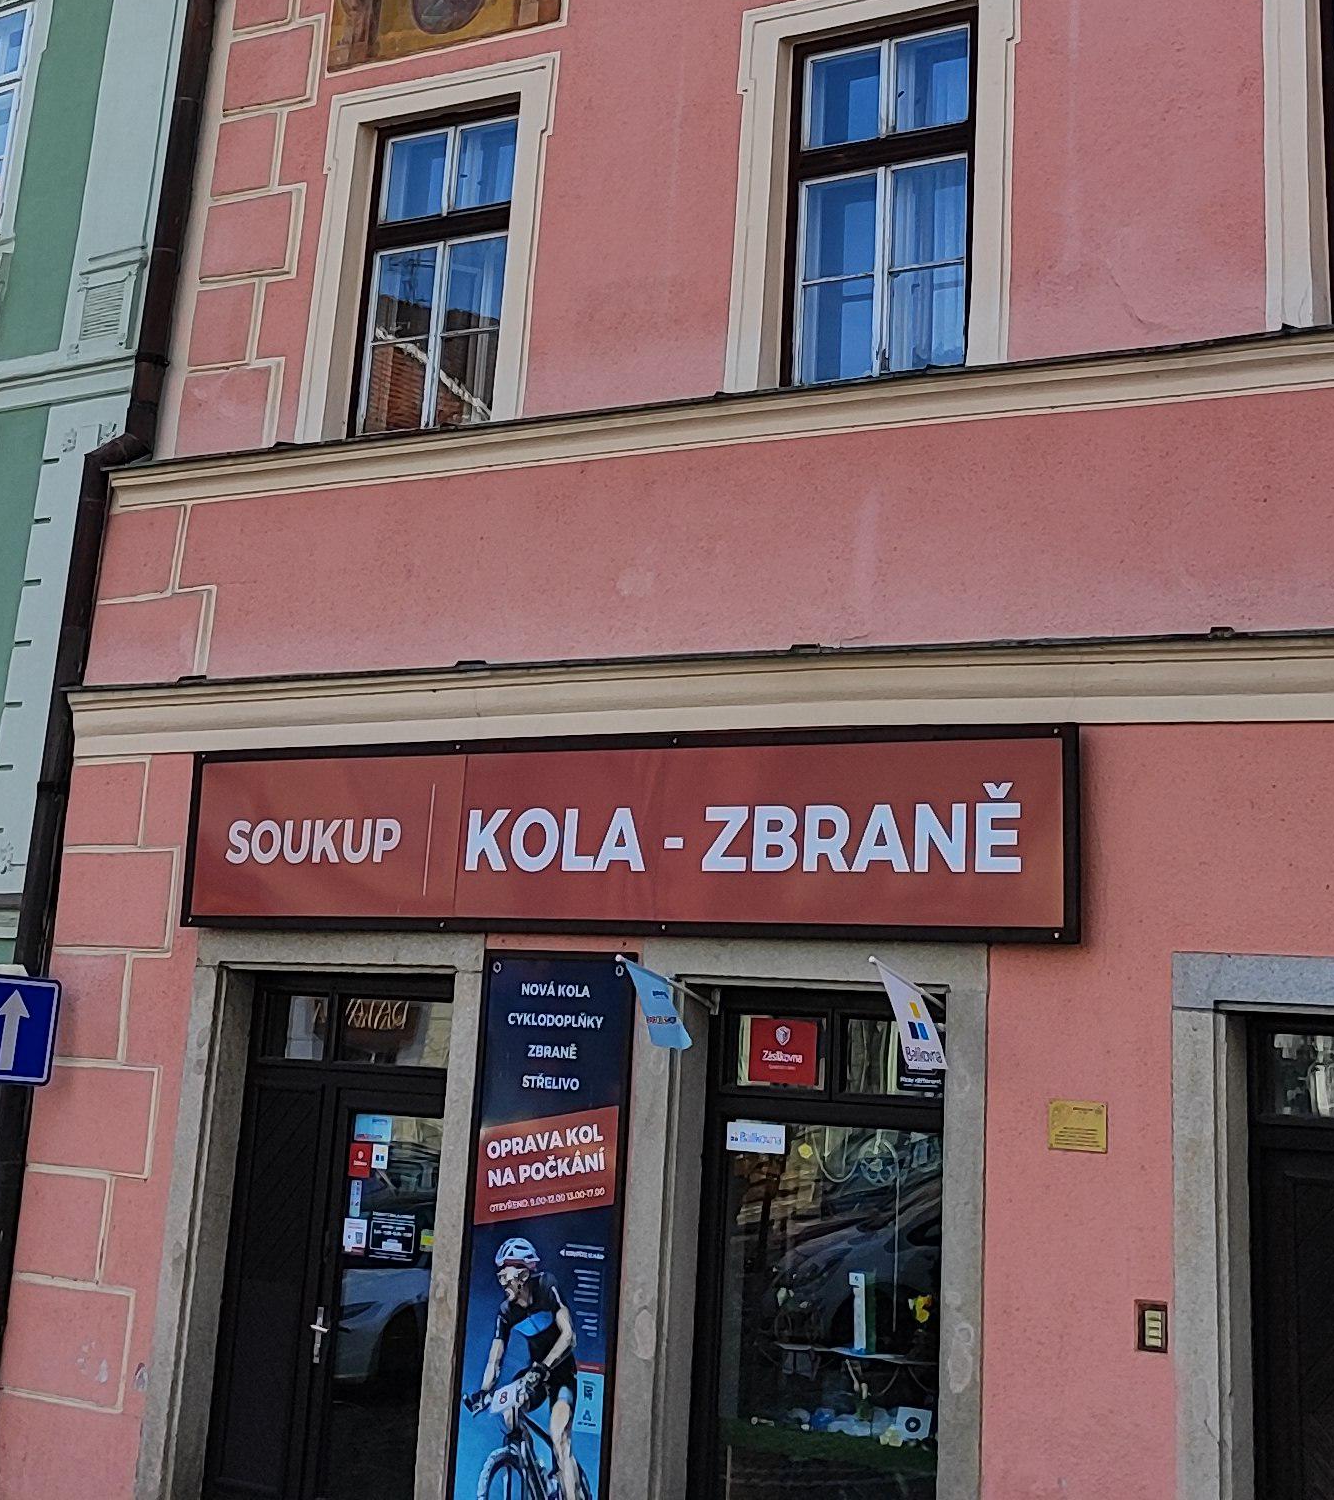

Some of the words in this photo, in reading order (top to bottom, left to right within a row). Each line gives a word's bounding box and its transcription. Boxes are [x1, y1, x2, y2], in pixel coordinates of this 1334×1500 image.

[224, 817, 402, 865] SOUKUP
[465, 806, 646, 873] KOLA
[699, 781, 1024, 874] ZBRANĚ
[520, 981, 555, 998] NOVÁ
[557, 983, 591, 999] KOLA
[507, 1011, 604, 1030] CYKLODOPLŇKY
[527, 1043, 578, 1060] ZBRANĚ
[521, 1073, 581, 1091] STŘELIVO
[486, 1128, 566, 1160] OPRAVA
[565, 1123, 604, 1144] KOL
[487, 1167, 516, 1188] NA
[518, 1146, 606, 1184] POČKÁNÍ
